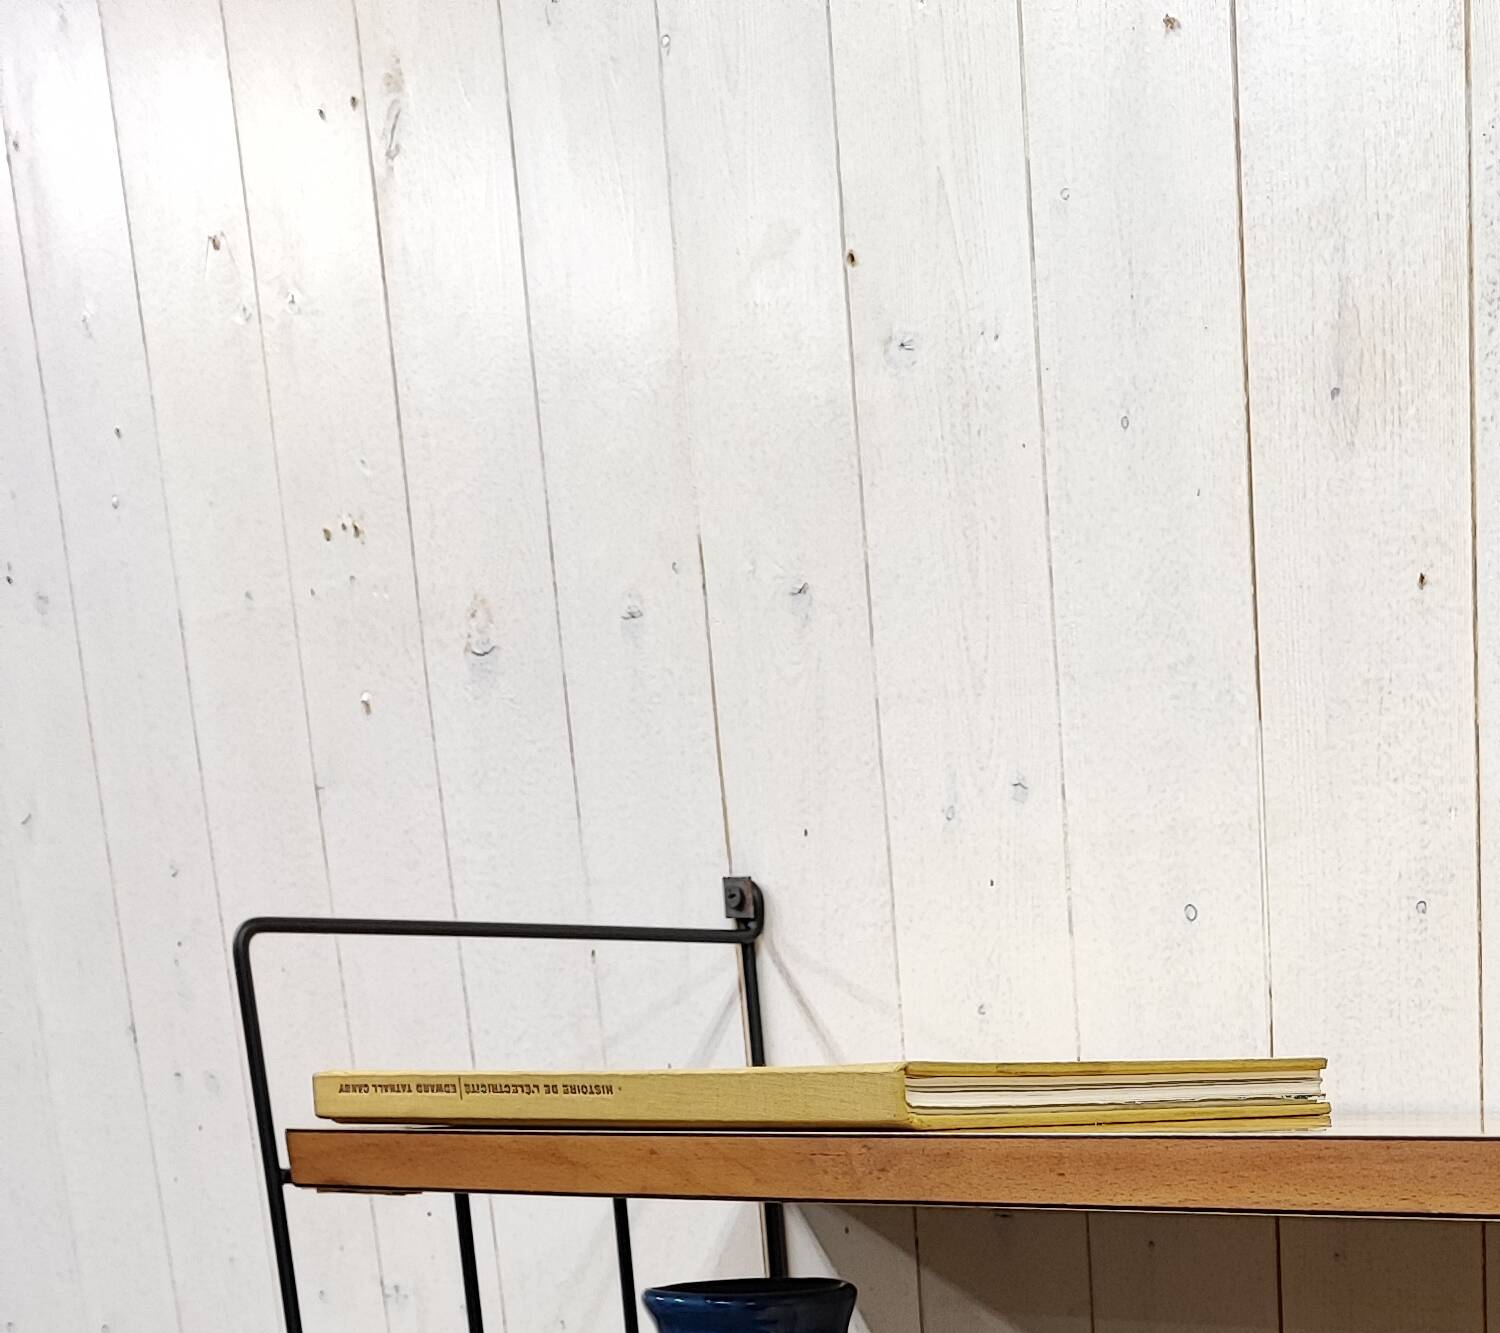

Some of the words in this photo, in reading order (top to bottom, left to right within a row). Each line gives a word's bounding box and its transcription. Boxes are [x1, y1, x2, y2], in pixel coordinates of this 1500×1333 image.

[416, 1084, 457, 1094] EDWARD
[544, 1084, 559, 1095] DE
[562, 1084, 614, 1095] HISTOIRE
